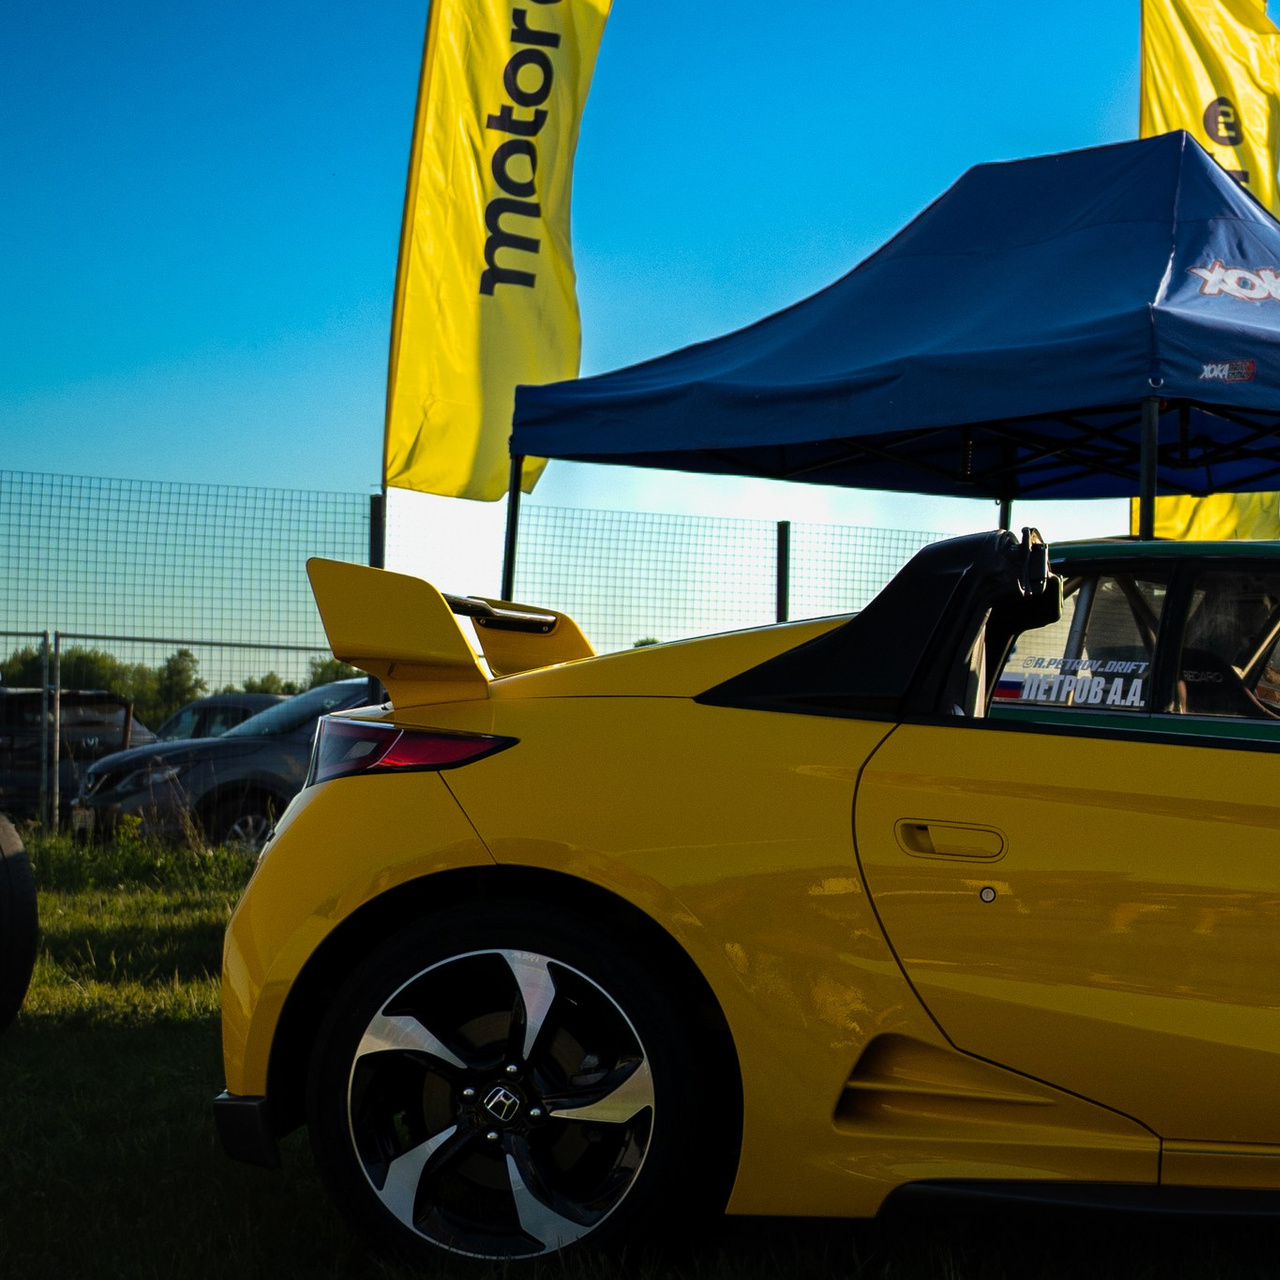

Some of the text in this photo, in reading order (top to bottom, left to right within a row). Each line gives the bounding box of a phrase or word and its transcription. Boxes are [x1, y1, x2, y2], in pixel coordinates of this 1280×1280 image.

[479, 8, 561, 297] motor
[1022, 673, 1145, 707] ПЕТРОВ А.А.
